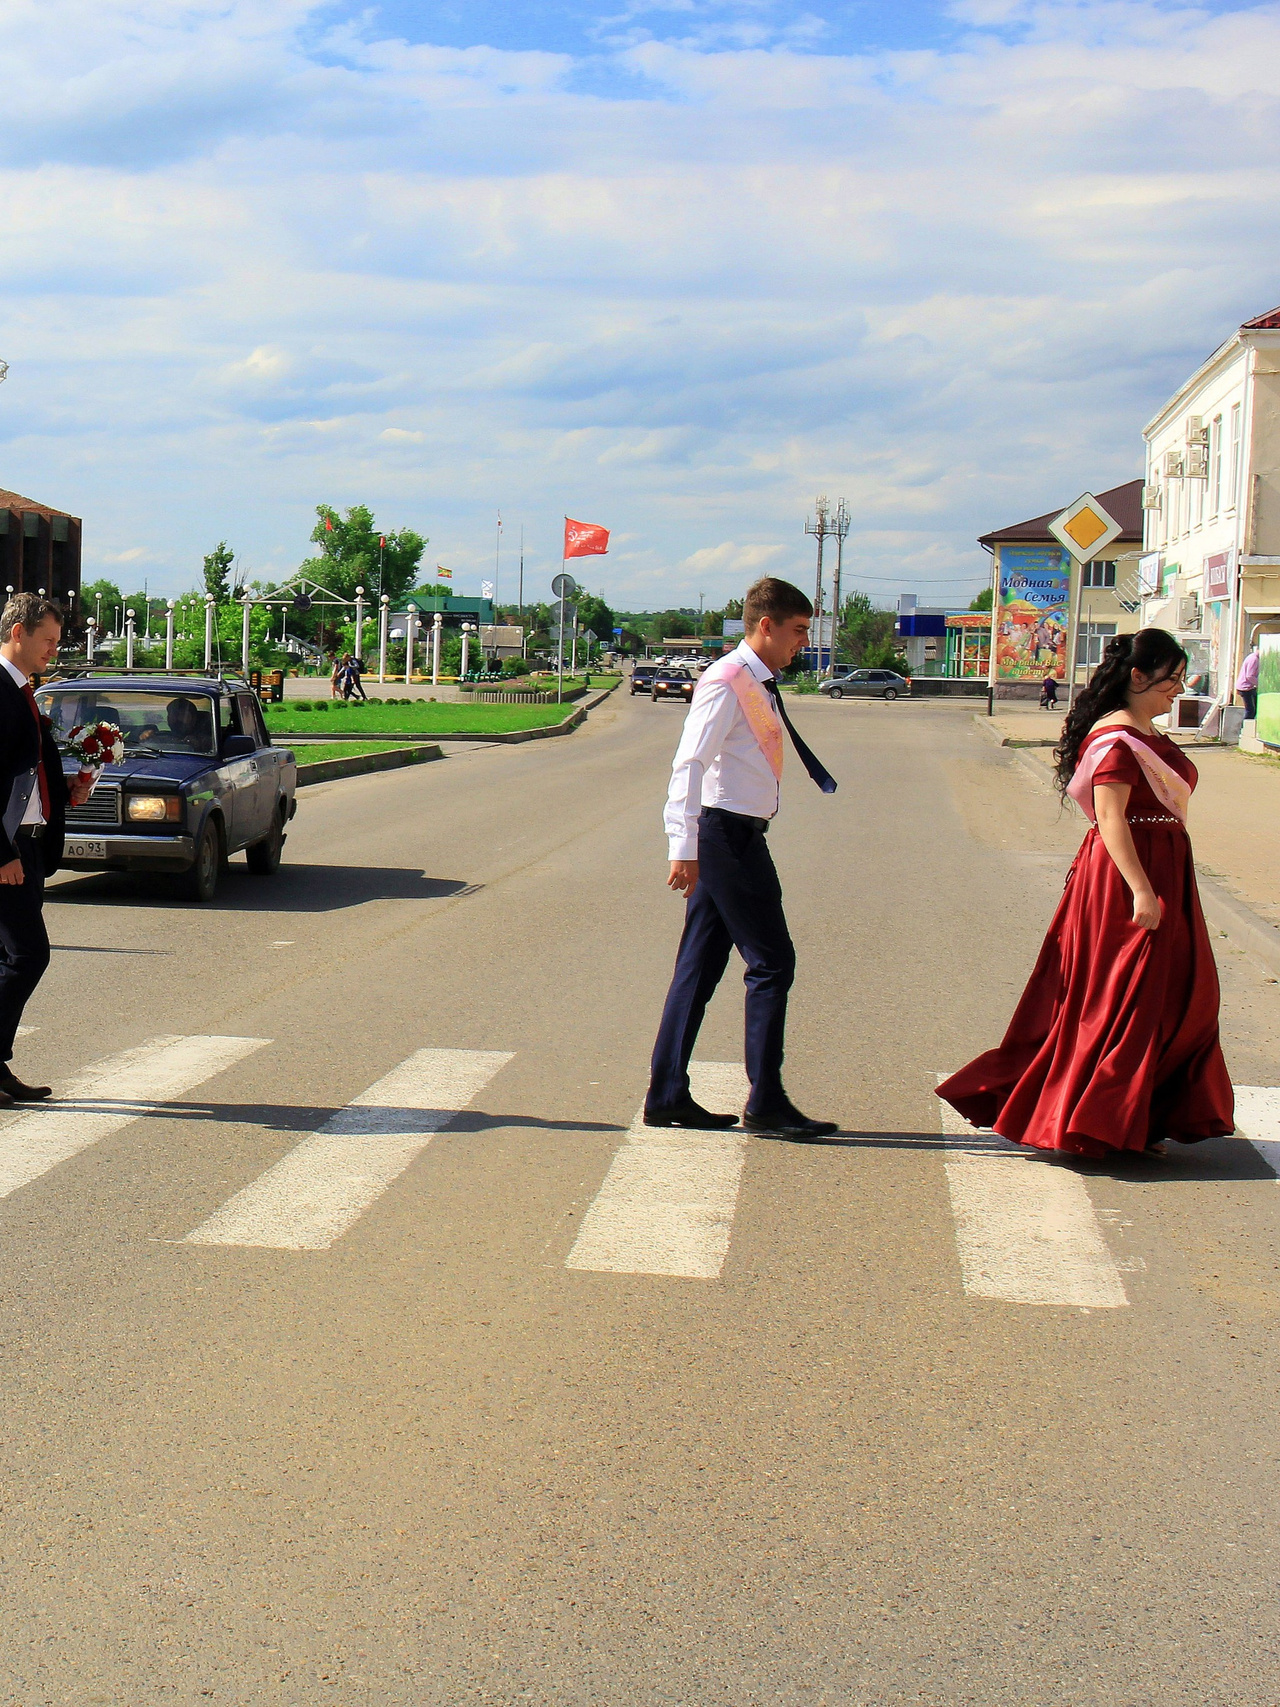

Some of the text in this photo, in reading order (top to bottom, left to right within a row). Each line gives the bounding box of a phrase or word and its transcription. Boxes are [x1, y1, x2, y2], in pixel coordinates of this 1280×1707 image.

[1002, 577, 1053, 588] Модная
[1024, 591, 1065, 602] Семья
[88, 842, 101, 853] 93
